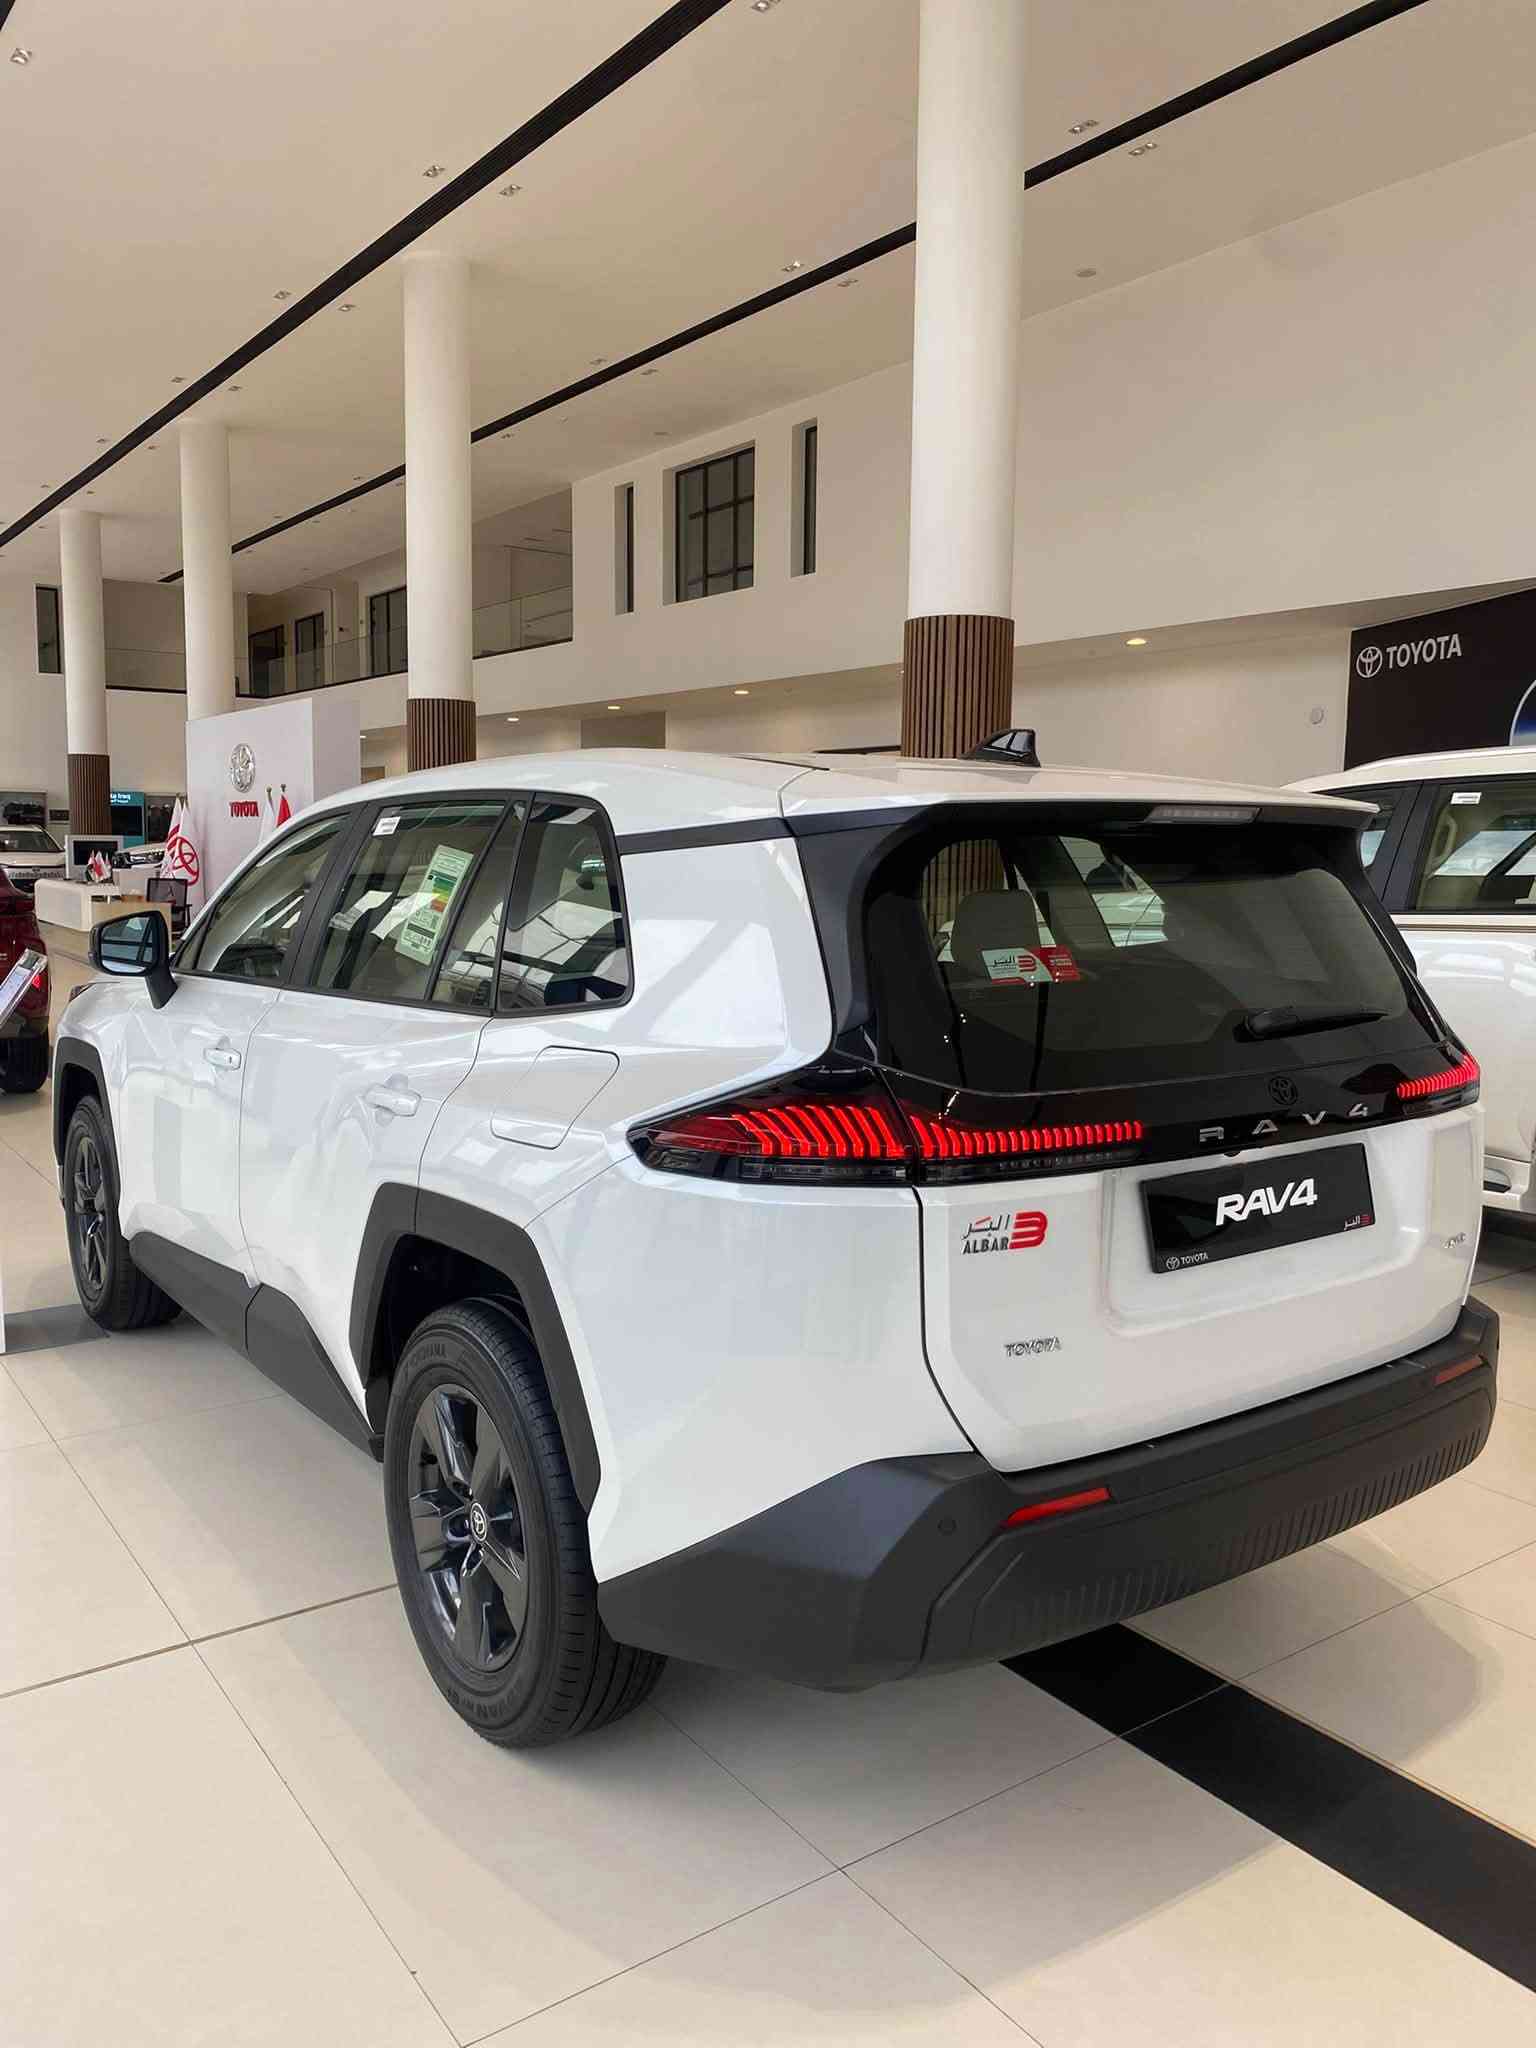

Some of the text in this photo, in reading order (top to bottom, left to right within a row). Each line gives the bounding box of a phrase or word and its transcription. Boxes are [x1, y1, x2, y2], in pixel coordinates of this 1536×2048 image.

[1386, 633, 1462, 669] TOYOTA
[229, 801, 259, 817] TOYOTA
[1199, 1103, 1368, 1142] RAV4
[1215, 1178, 1318, 1226] RAV4
[963, 1237, 1009, 1255] ALBAR
[1180, 1252, 1209, 1265] TOYOTA
[1004, 1337, 1062, 1357] TOYOTA
